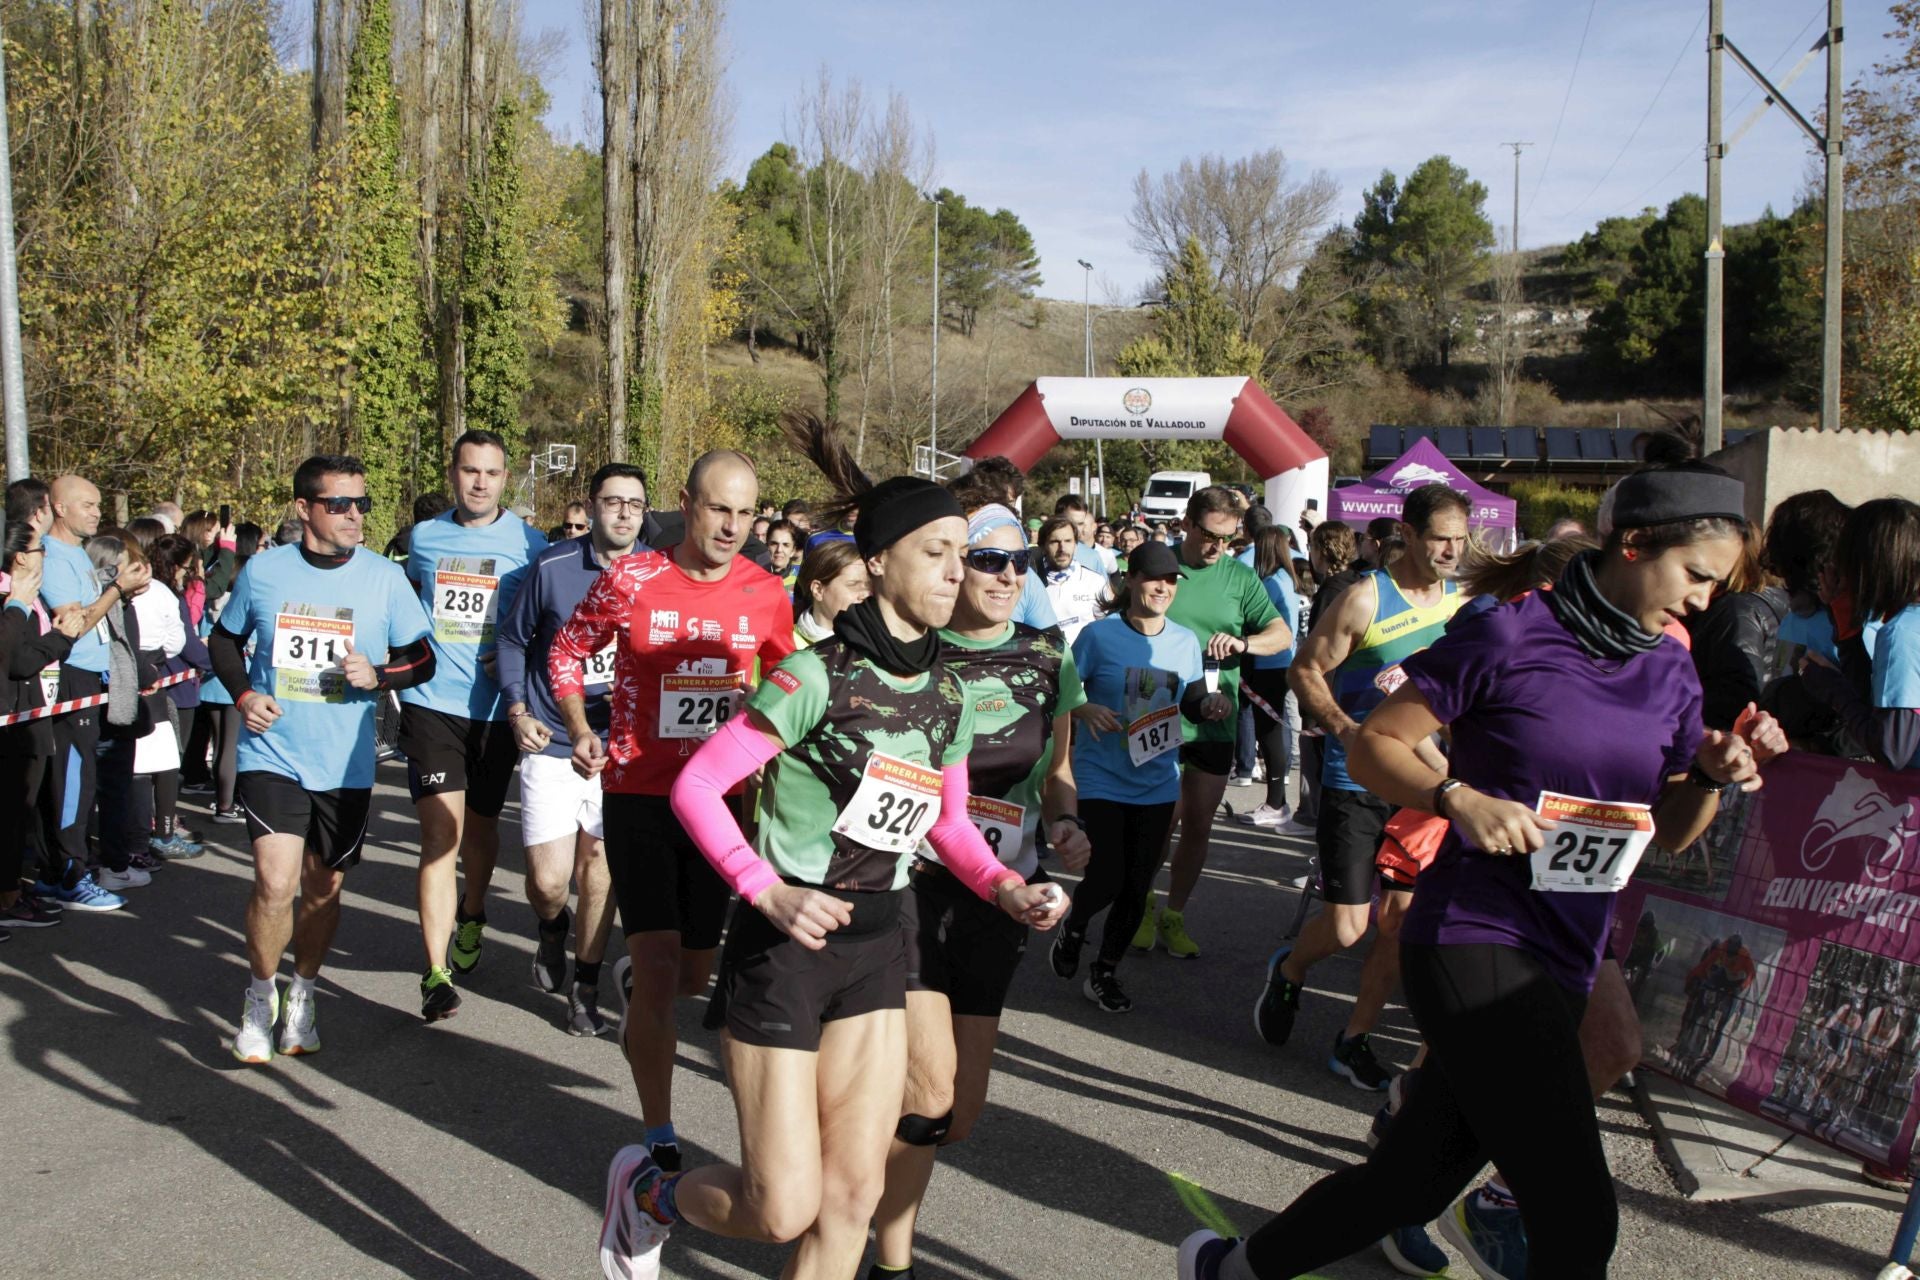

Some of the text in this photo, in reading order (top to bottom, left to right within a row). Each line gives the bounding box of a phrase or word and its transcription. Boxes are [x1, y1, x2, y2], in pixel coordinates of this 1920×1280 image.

[467, 577, 496, 585] POPULAR
[444, 589, 484, 613] 238
[280, 617, 316, 627] CARRERA
[317, 621, 351, 631] POPULAR
[1381, 618, 1409, 635] luanvi
[289, 635, 335, 662] 311
[677, 696, 730, 725] 226
[976, 698, 1007, 712] ATP
[1138, 722, 1169, 752] 187
[421, 772, 447, 786] EA7
[867, 791, 929, 837] 320
[979, 801, 1019, 817] POPULAR
[1545, 800, 1649, 821] CARRERA POPULAR
[1548, 831, 1629, 875] 257
